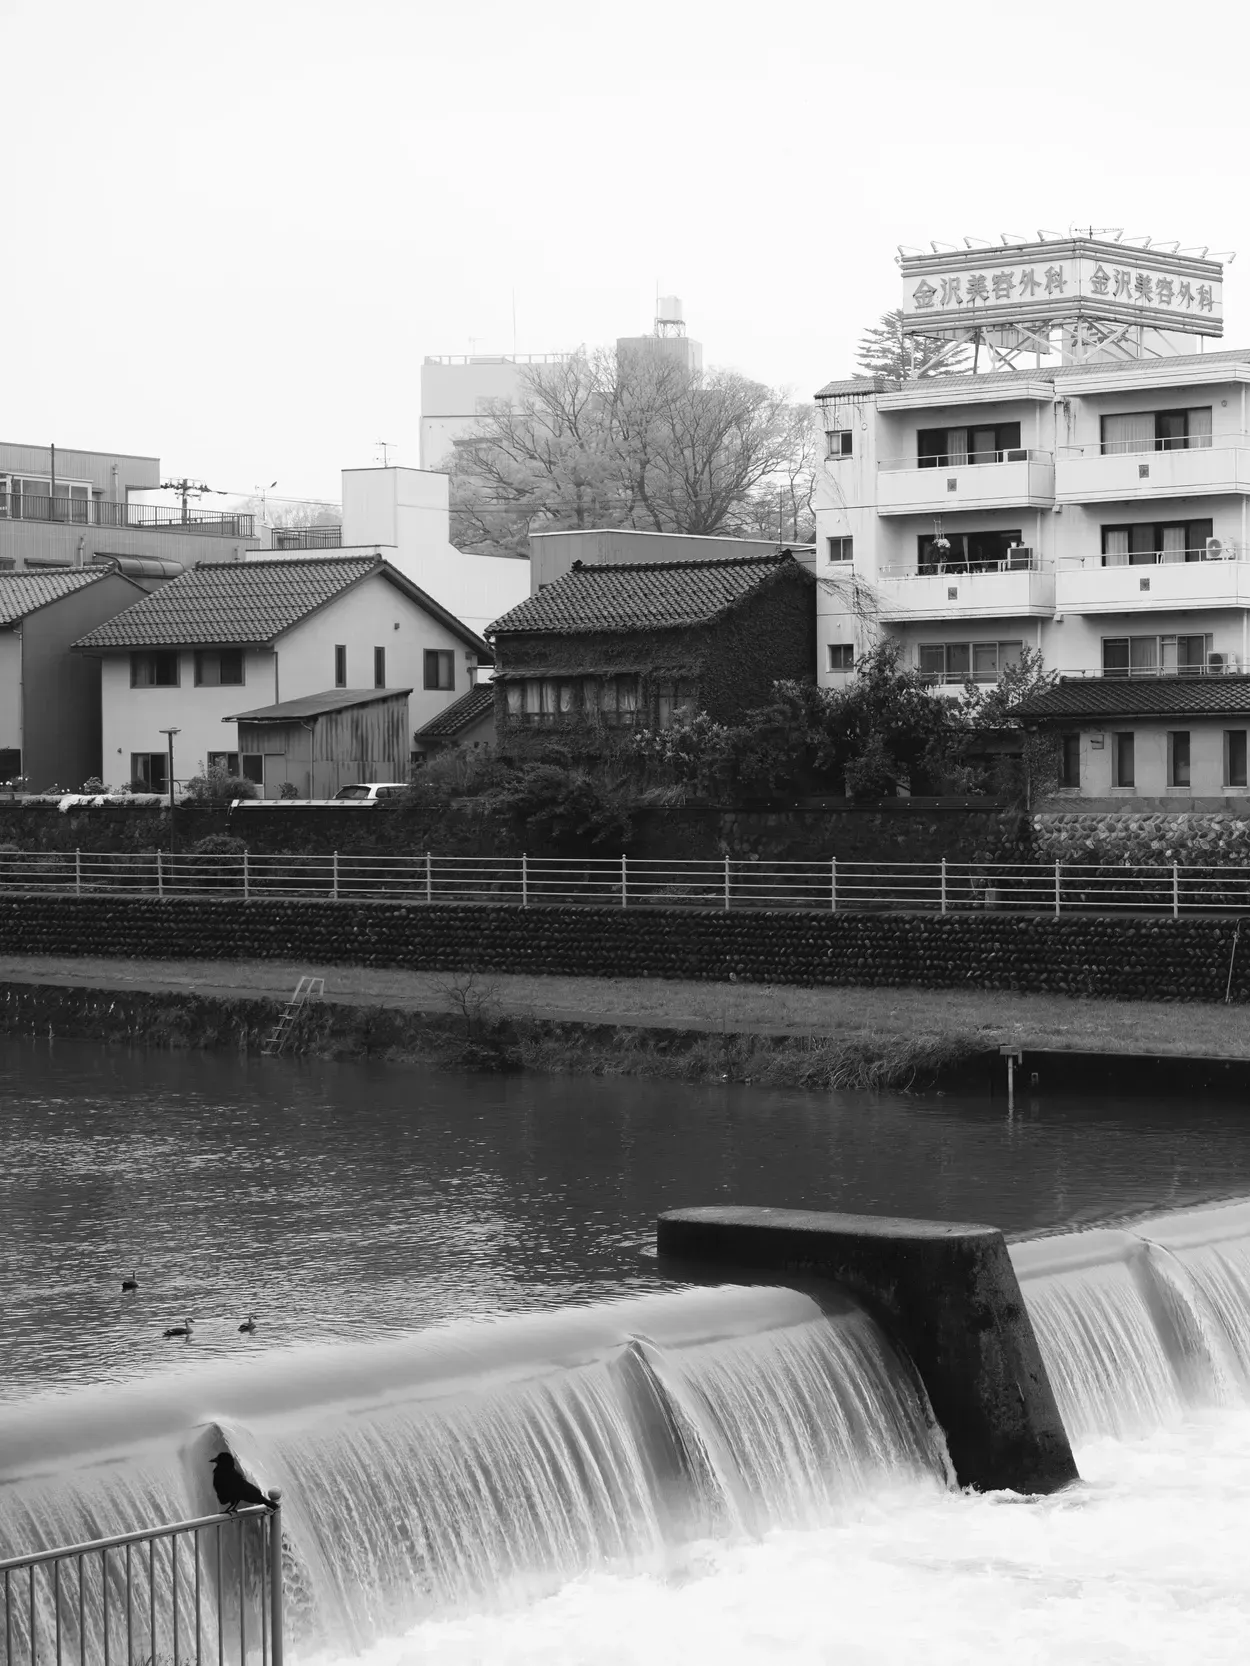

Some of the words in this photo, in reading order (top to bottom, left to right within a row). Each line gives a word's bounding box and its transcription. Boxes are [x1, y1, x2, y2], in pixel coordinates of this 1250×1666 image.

[913, 265, 1067, 308] 金沢美容外科
[1090, 265, 1214, 312] 金沢美容外科
